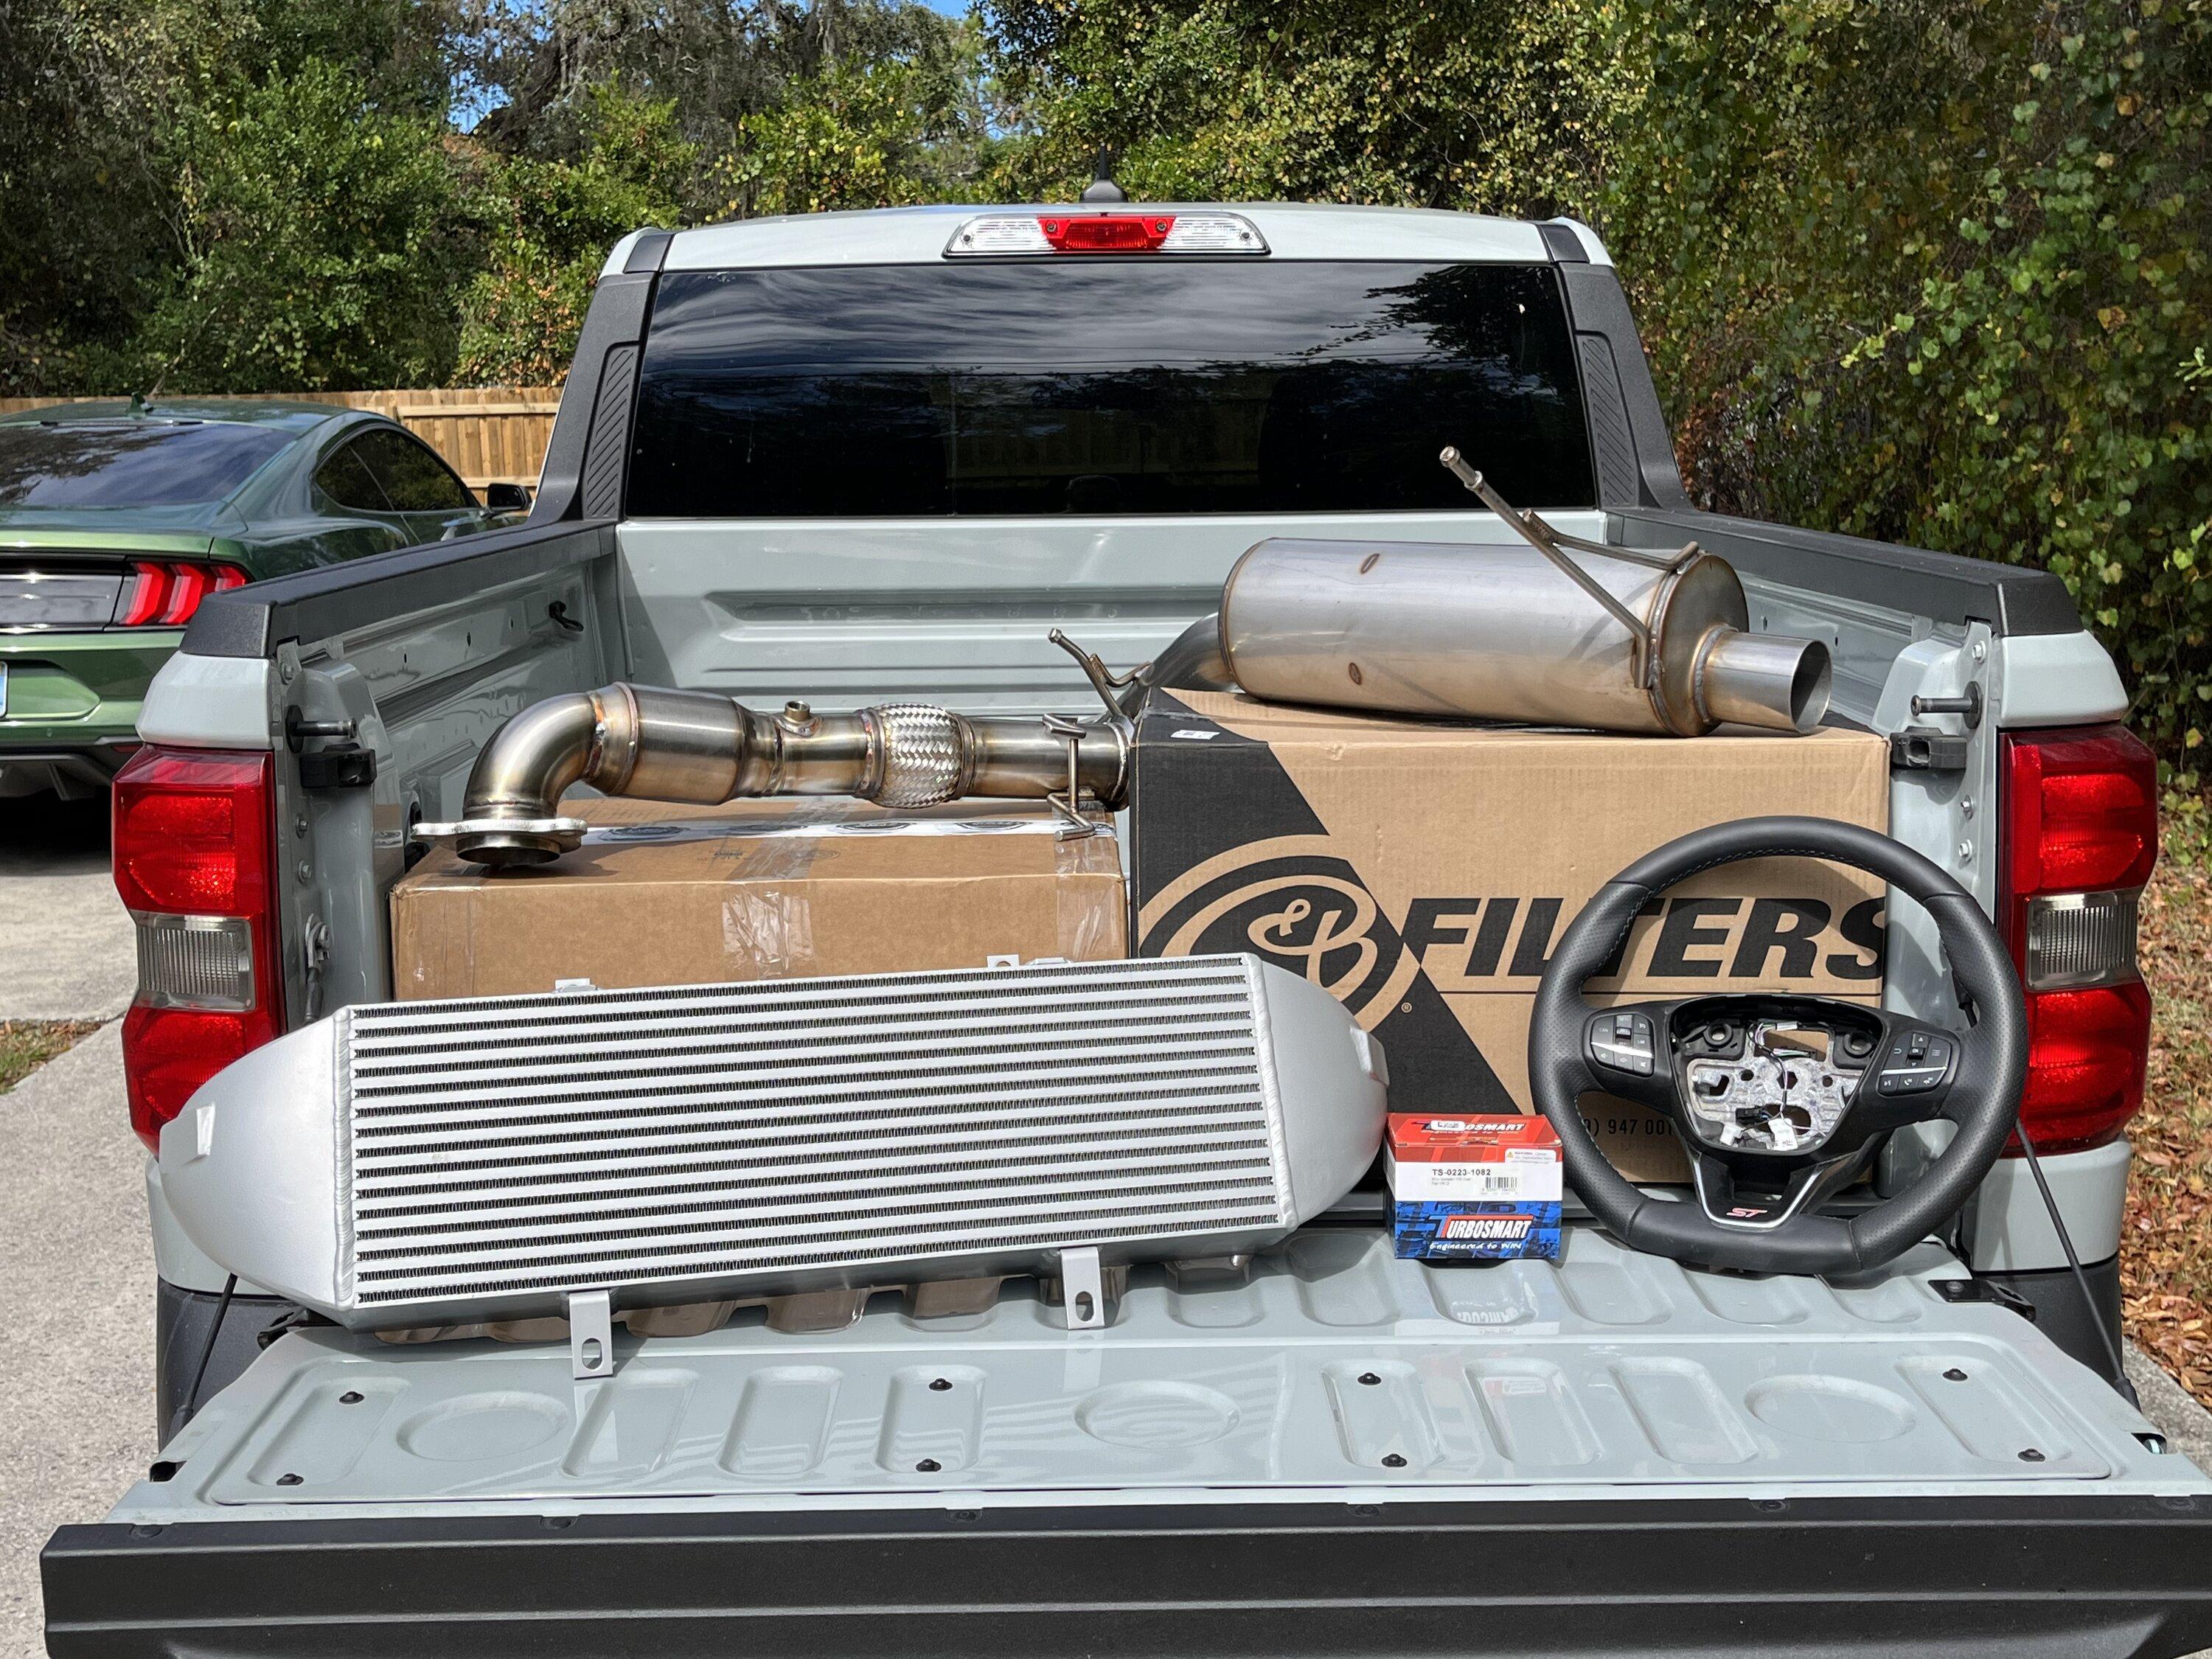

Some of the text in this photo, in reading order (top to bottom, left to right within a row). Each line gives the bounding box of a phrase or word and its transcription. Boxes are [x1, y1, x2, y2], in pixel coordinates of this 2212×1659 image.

[1608, 1119, 1638, 1134] 947
[1726, 1208, 1768, 1217] ST
[1429, 1215, 1534, 1239] TURBOSMART
[1429, 1242, 1484, 1251] Engineered
